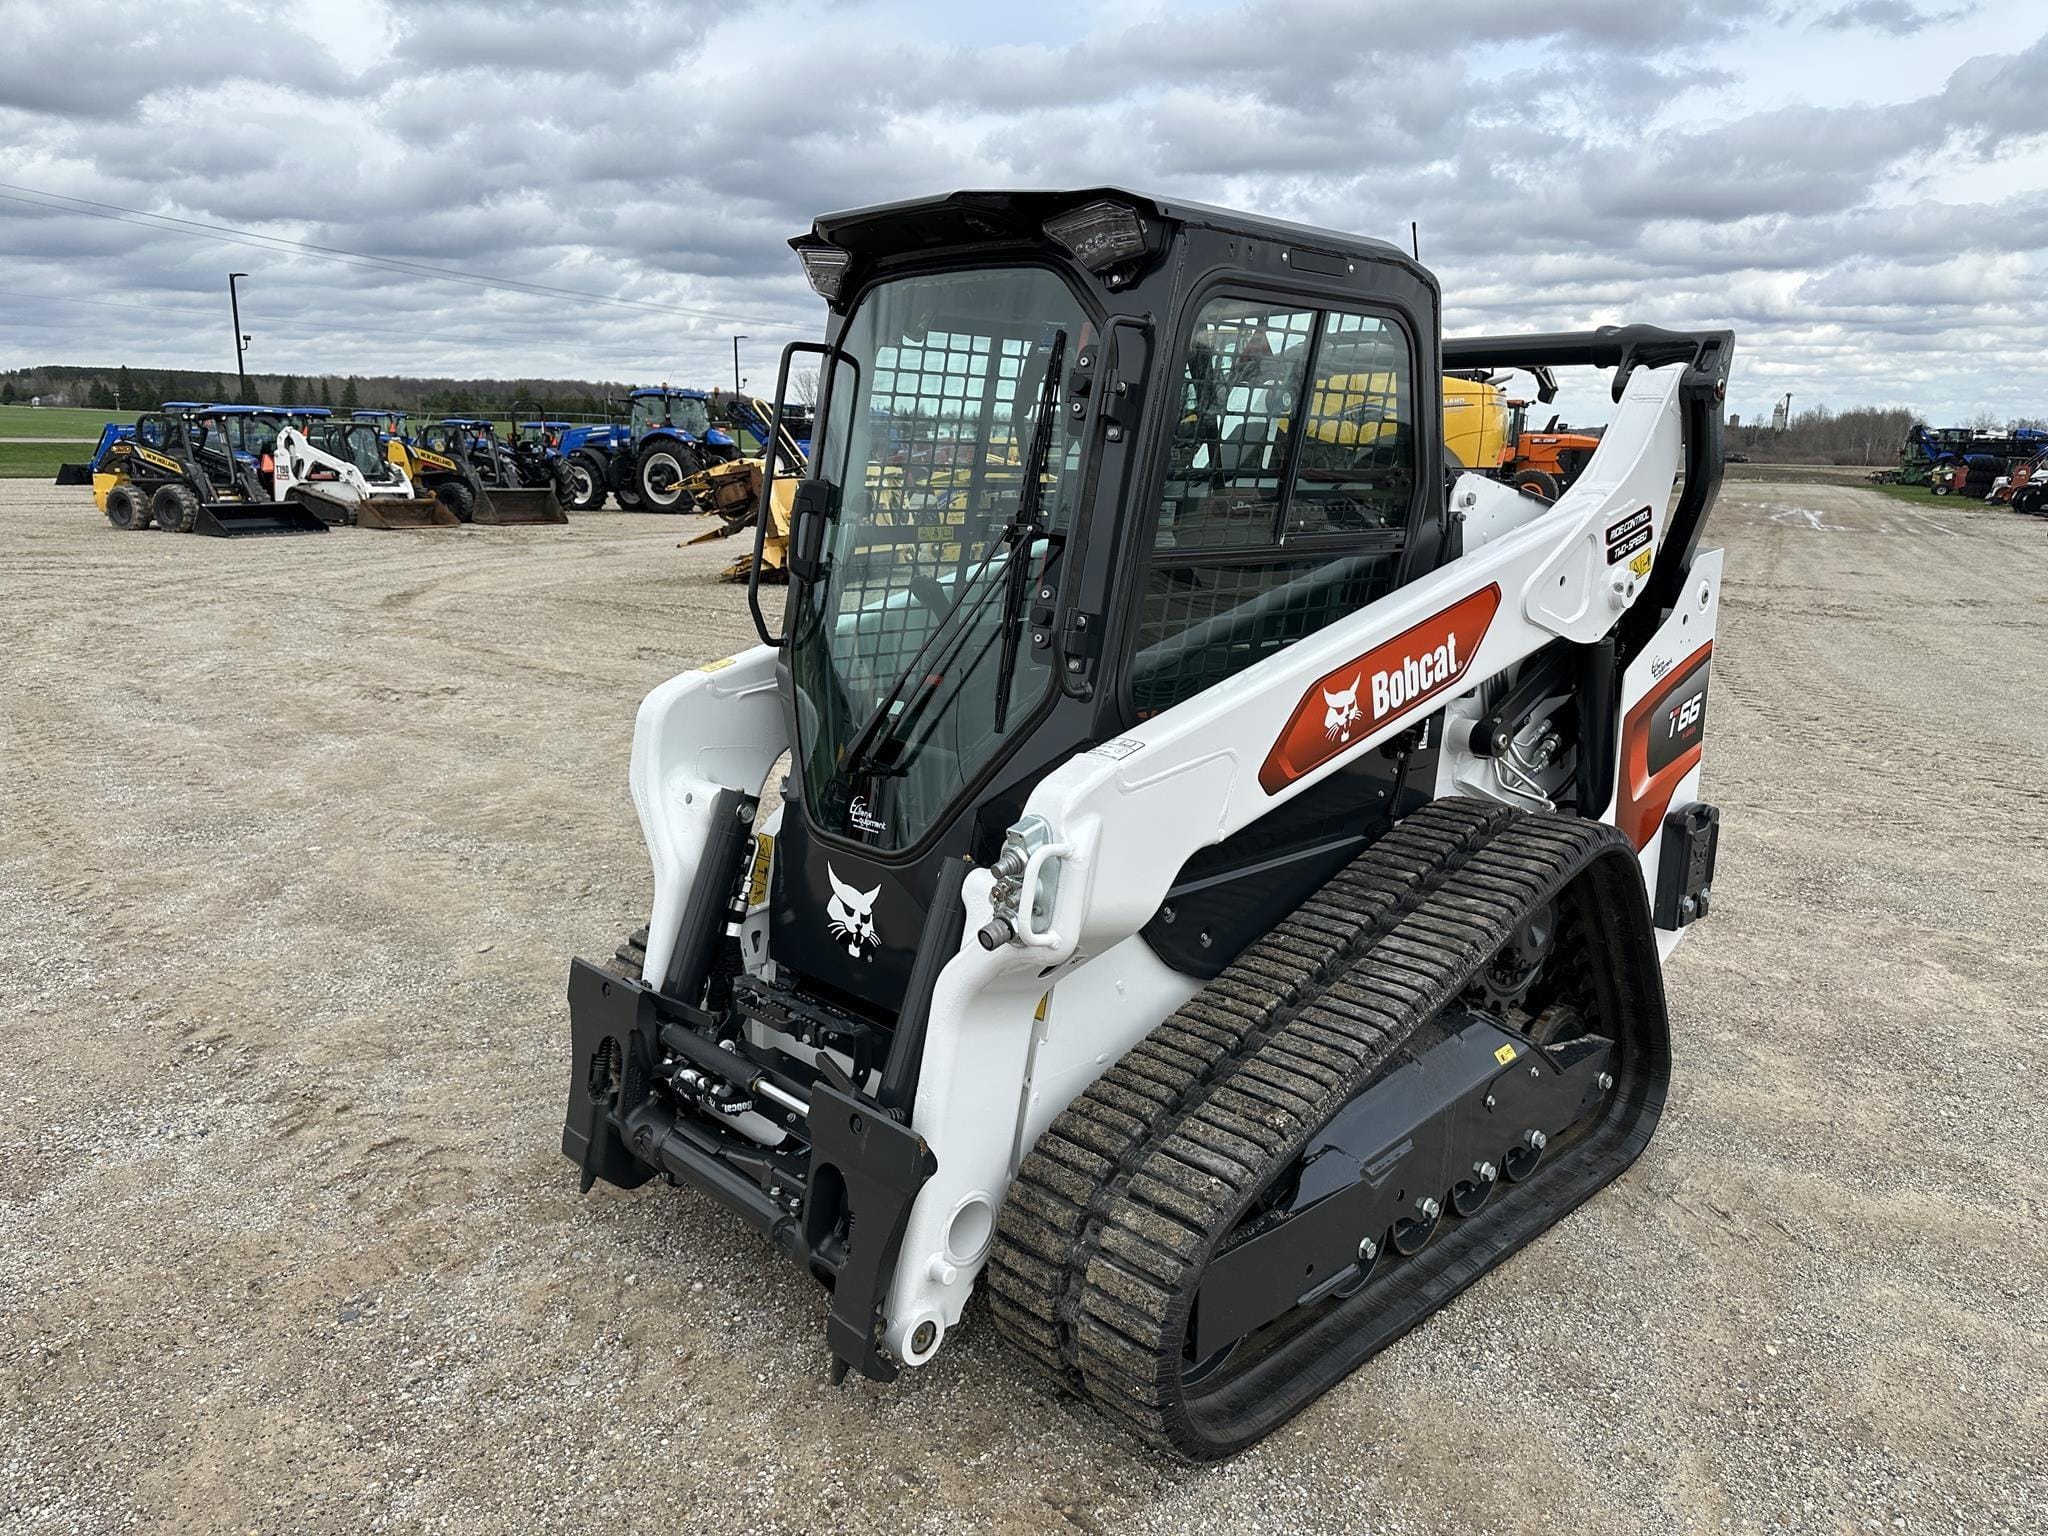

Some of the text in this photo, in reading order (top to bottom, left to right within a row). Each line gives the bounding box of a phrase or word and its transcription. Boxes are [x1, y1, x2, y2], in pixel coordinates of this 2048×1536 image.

[1444, 397, 1465, 405] LAND
[276, 465, 289, 474] T190
[1609, 510, 1650, 541] RIDE CONTROL
[1614, 530, 1648, 559] TWO-SPEED
[1371, 632, 1457, 720] Bobcat
[1668, 691, 1703, 739] T66
